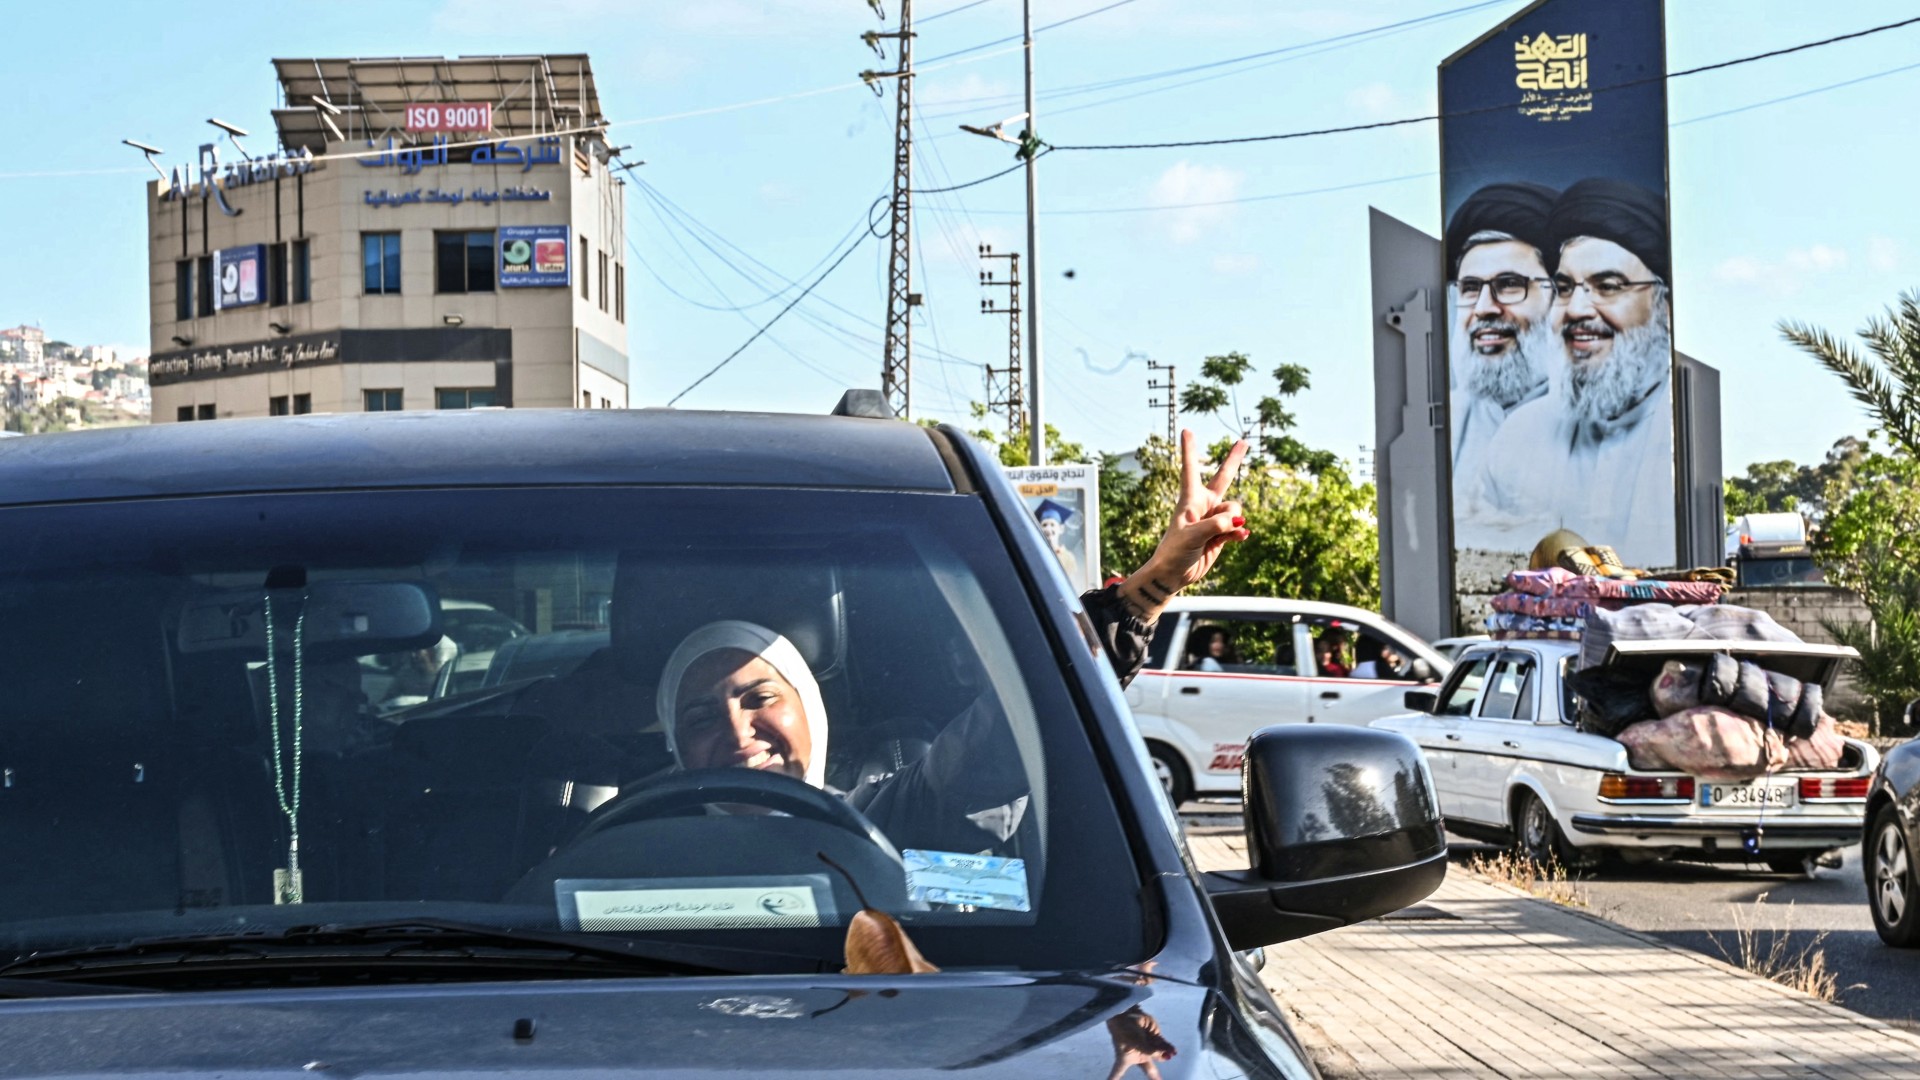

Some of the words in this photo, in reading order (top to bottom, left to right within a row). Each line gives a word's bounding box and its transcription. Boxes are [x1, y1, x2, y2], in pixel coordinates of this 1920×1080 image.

[407, 107, 440, 128] ISO
[445, 107, 488, 128] 9001
[471, 135, 561, 173] شركة
[169, 163, 191, 200] Al
[150, 356, 189, 375] ontracting
[193, 352, 222, 371] Trading
[1731, 787, 1782, 803] 334948
